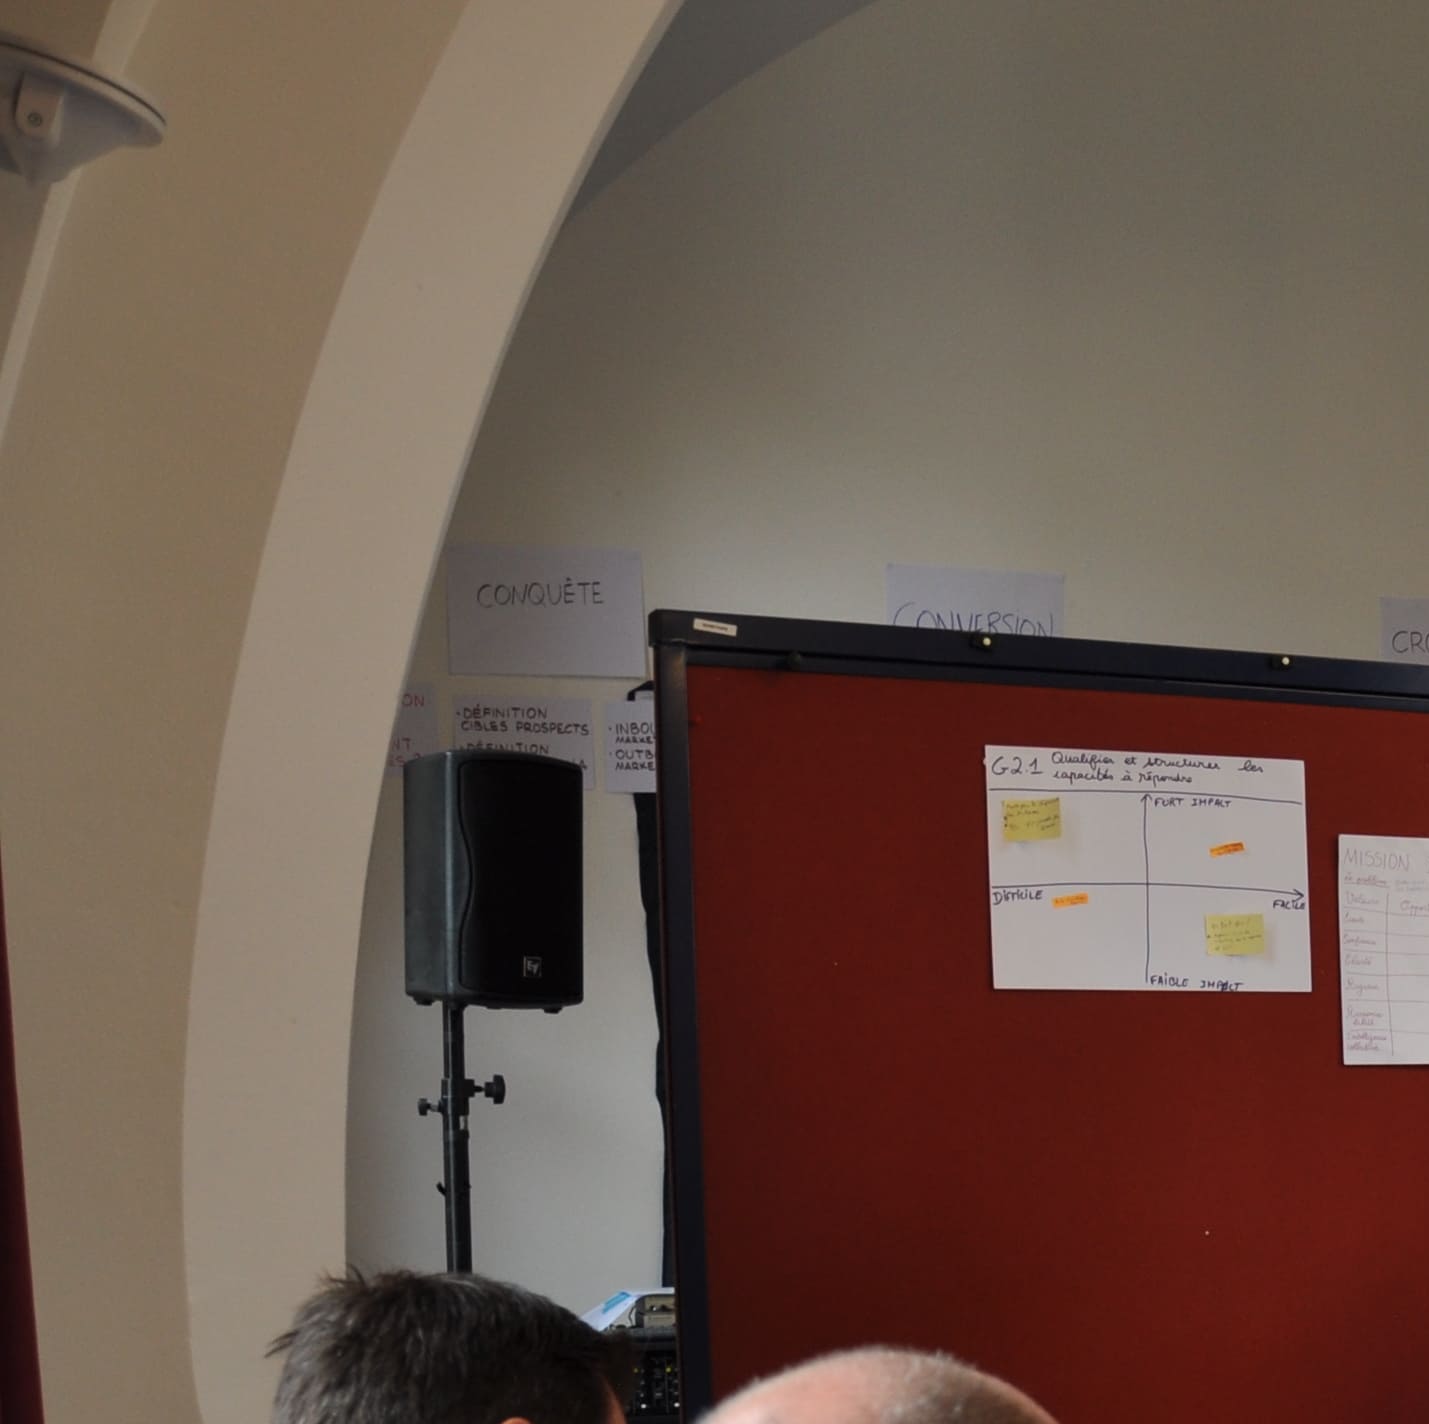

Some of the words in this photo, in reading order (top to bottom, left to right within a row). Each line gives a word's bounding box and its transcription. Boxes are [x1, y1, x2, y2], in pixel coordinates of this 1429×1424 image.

[476, 577, 604, 608] CONQUÊTE
[463, 703, 547, 719] DÉFINITION
[460, 721, 508, 733] CIBLES
[516, 722, 589, 736] PROSPECTS
[1051, 751, 1115, 771] Qualifier
[1124, 756, 1137, 766] et
[1121, 770, 1133, 782] à
[1154, 798, 1184, 808] FORT
[1344, 848, 1410, 872] MISSION
